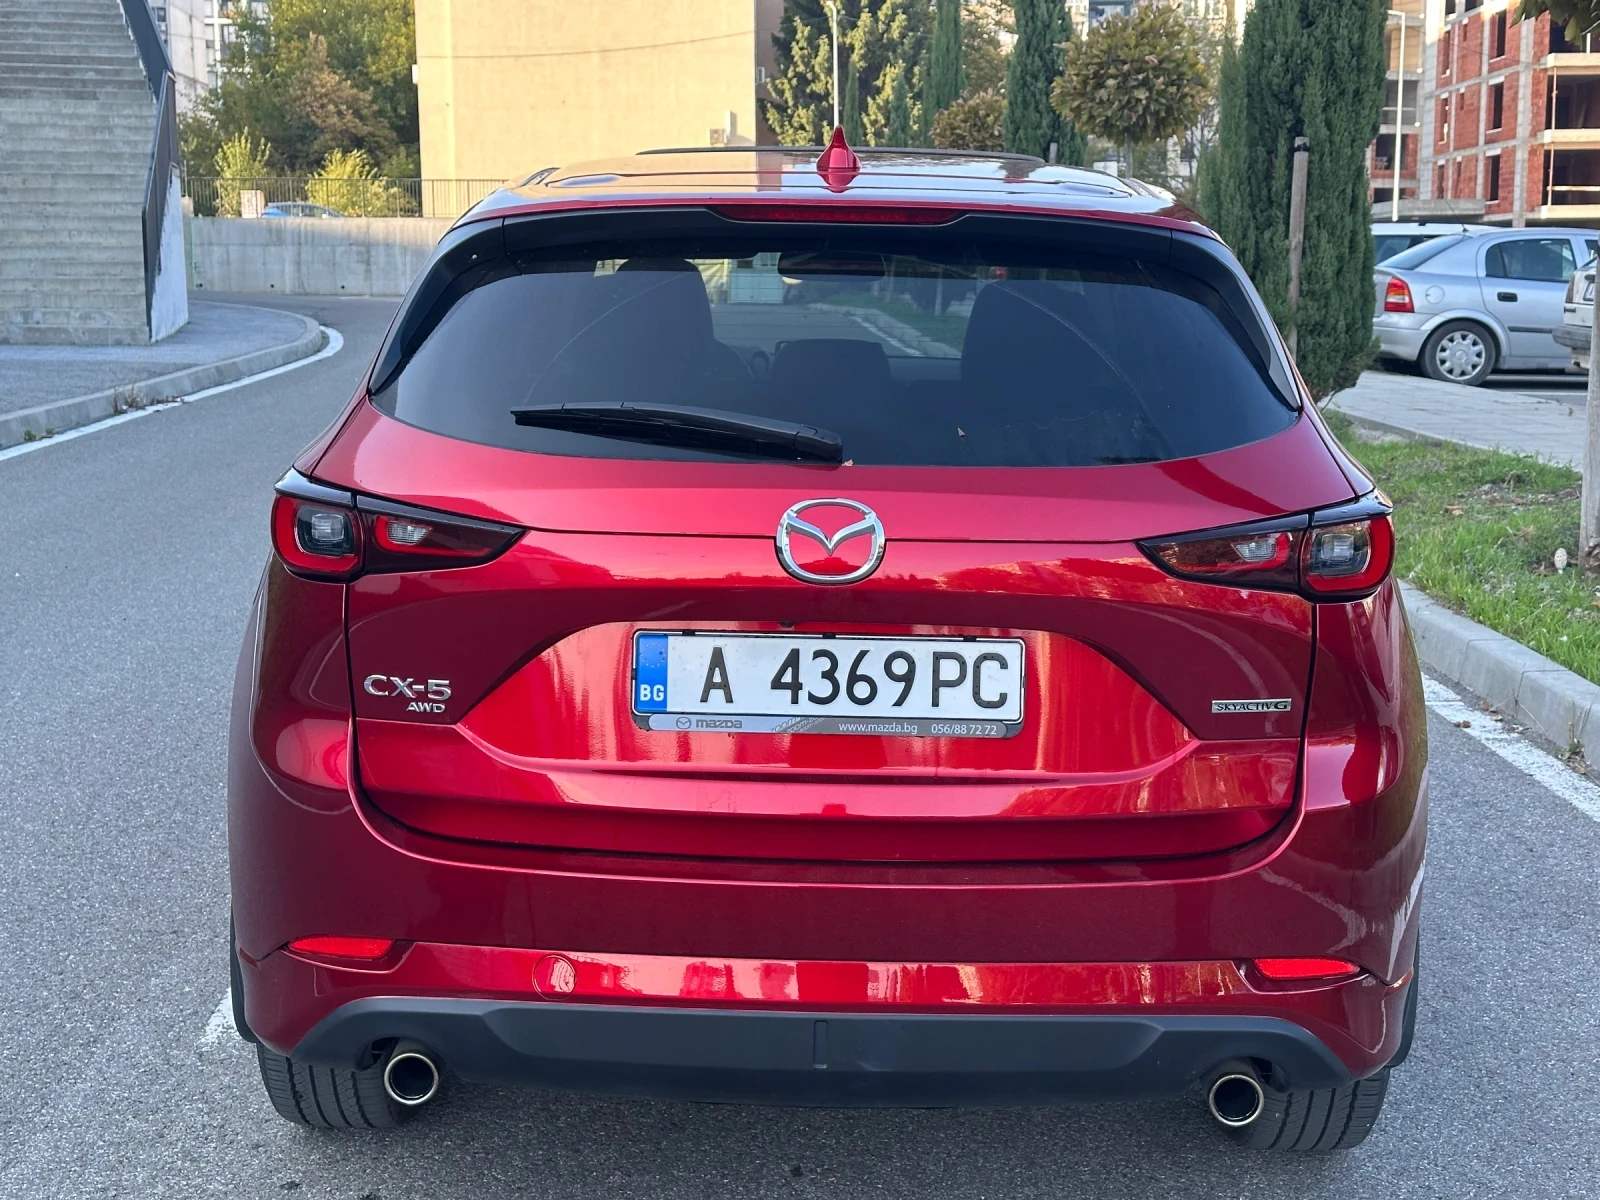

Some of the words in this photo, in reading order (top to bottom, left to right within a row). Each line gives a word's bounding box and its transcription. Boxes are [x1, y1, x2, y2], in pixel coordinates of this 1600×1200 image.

[700, 646, 734, 704] A
[770, 648, 917, 706] 4369
[931, 651, 1009, 709] PC
[363, 674, 452, 701] CX-5
[640, 684, 665, 701] BG
[406, 701, 446, 713] AWD
[838, 722, 918, 734] www.mazda.bg
